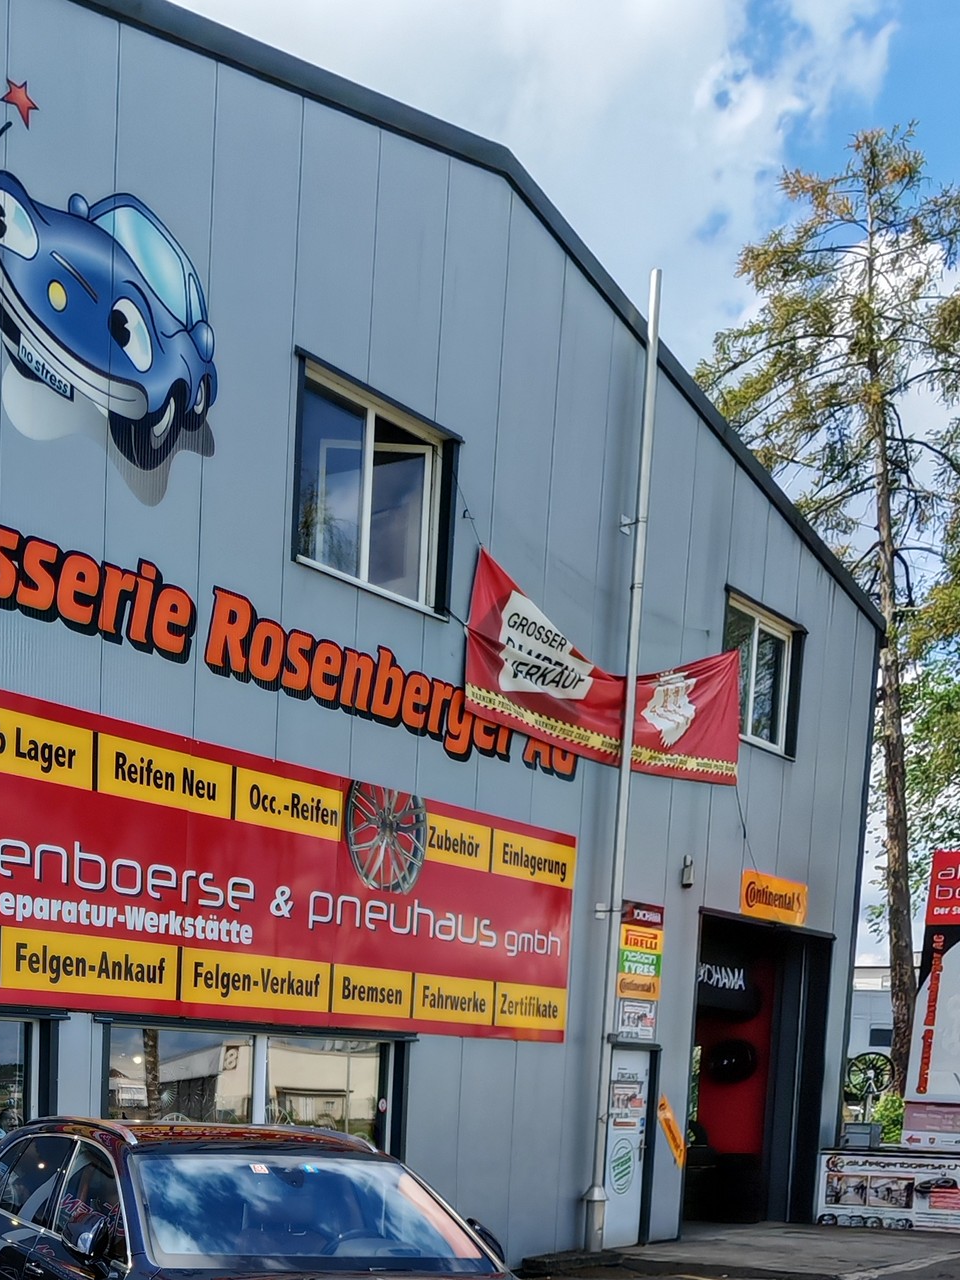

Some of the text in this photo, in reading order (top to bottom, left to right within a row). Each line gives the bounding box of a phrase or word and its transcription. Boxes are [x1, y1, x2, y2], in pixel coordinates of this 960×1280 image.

[21, 345, 69, 394] no stress
[507, 612, 567, 652] GROSSER
[15, 727, 76, 774] Lager
[114, 752, 217, 802] Reifen Neu
[249, 783, 338, 828] Occ.-Reifen
[428, 825, 480, 858] Zubehör
[502, 842, 567, 882] Einlagerung
[745, 881, 795, 911] Continental
[933, 906, 949, 915] Der
[270, 885, 294, 919] &
[308, 890, 496, 948] pneuhaus
[504, 929, 561, 957] gmbh
[624, 929, 658, 950] PIRELLI
[15, 942, 166, 985] Felgen-Ankauf
[193, 961, 320, 999] Felgen-Verkauf
[624, 962, 656, 976] TYRES
[342, 976, 403, 1006] Bremsen
[422, 985, 486, 1014] Fahrwerke
[500, 993, 559, 1020] Zertifikate
